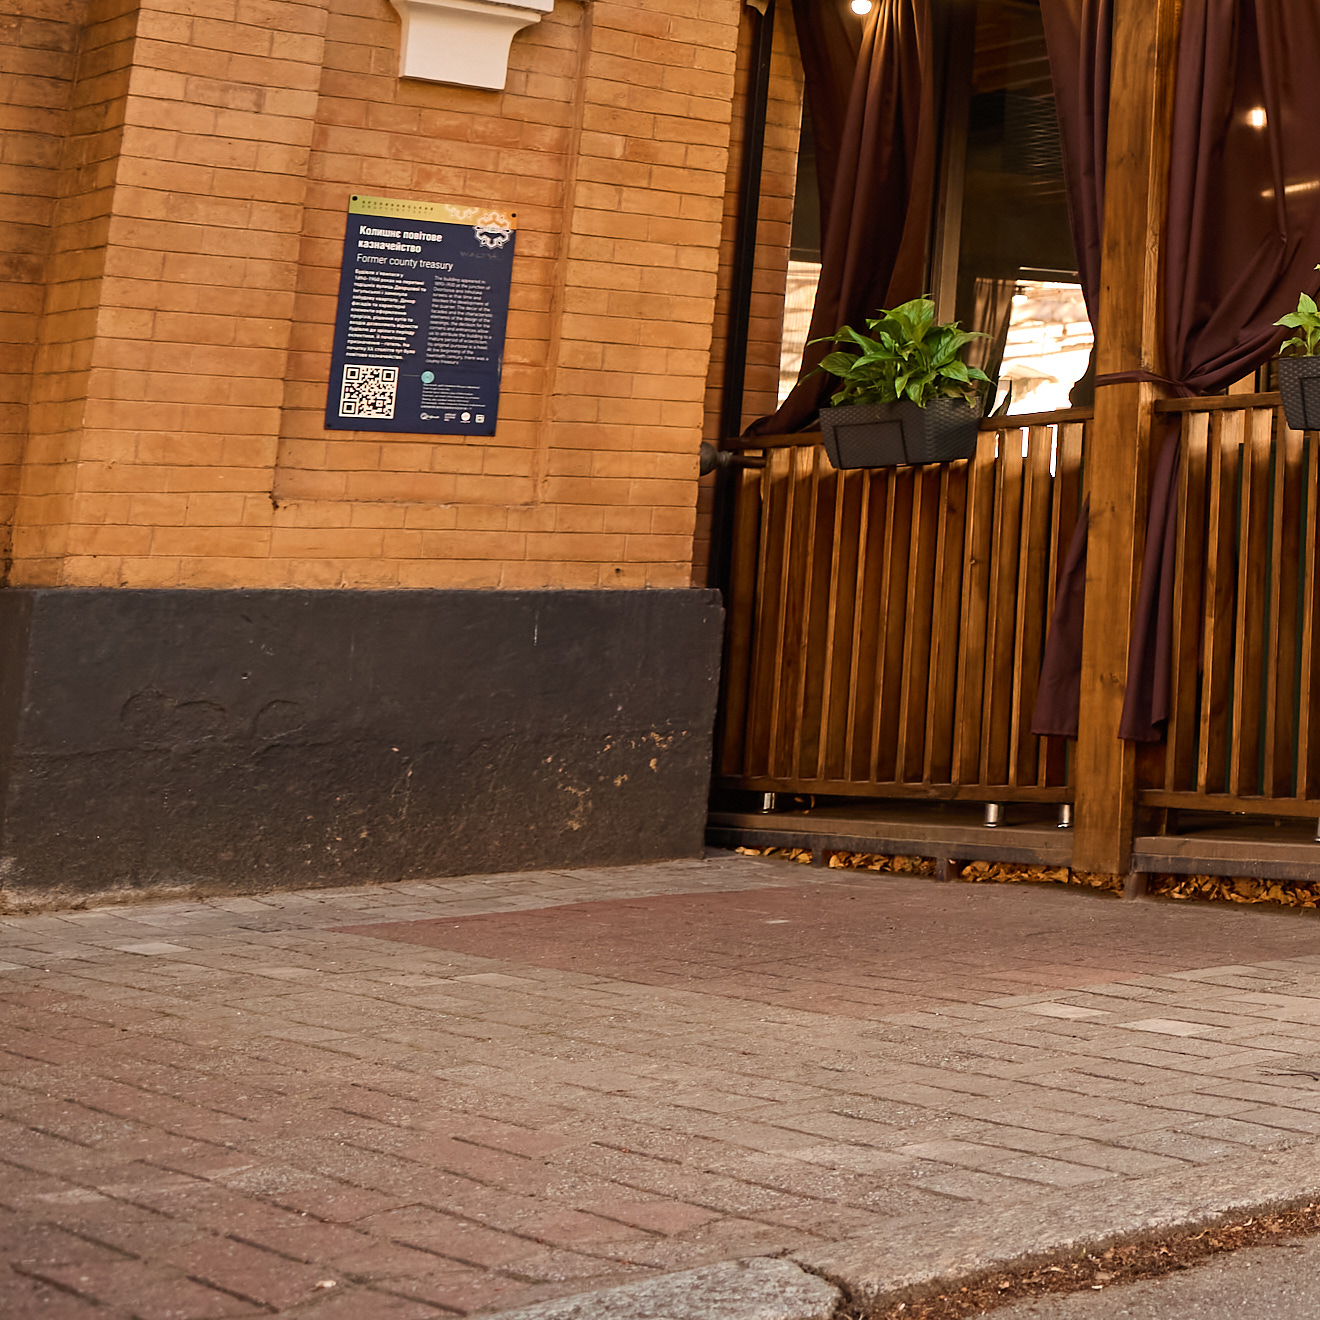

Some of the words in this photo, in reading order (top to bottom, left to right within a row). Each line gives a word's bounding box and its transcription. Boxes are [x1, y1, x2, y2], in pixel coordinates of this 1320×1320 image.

[402, 230, 443, 243] повітове
[358, 240, 422, 253] казначейство
[356, 253, 388, 265] Former
[389, 257, 418, 269] county
[419, 259, 454, 272] treasury
